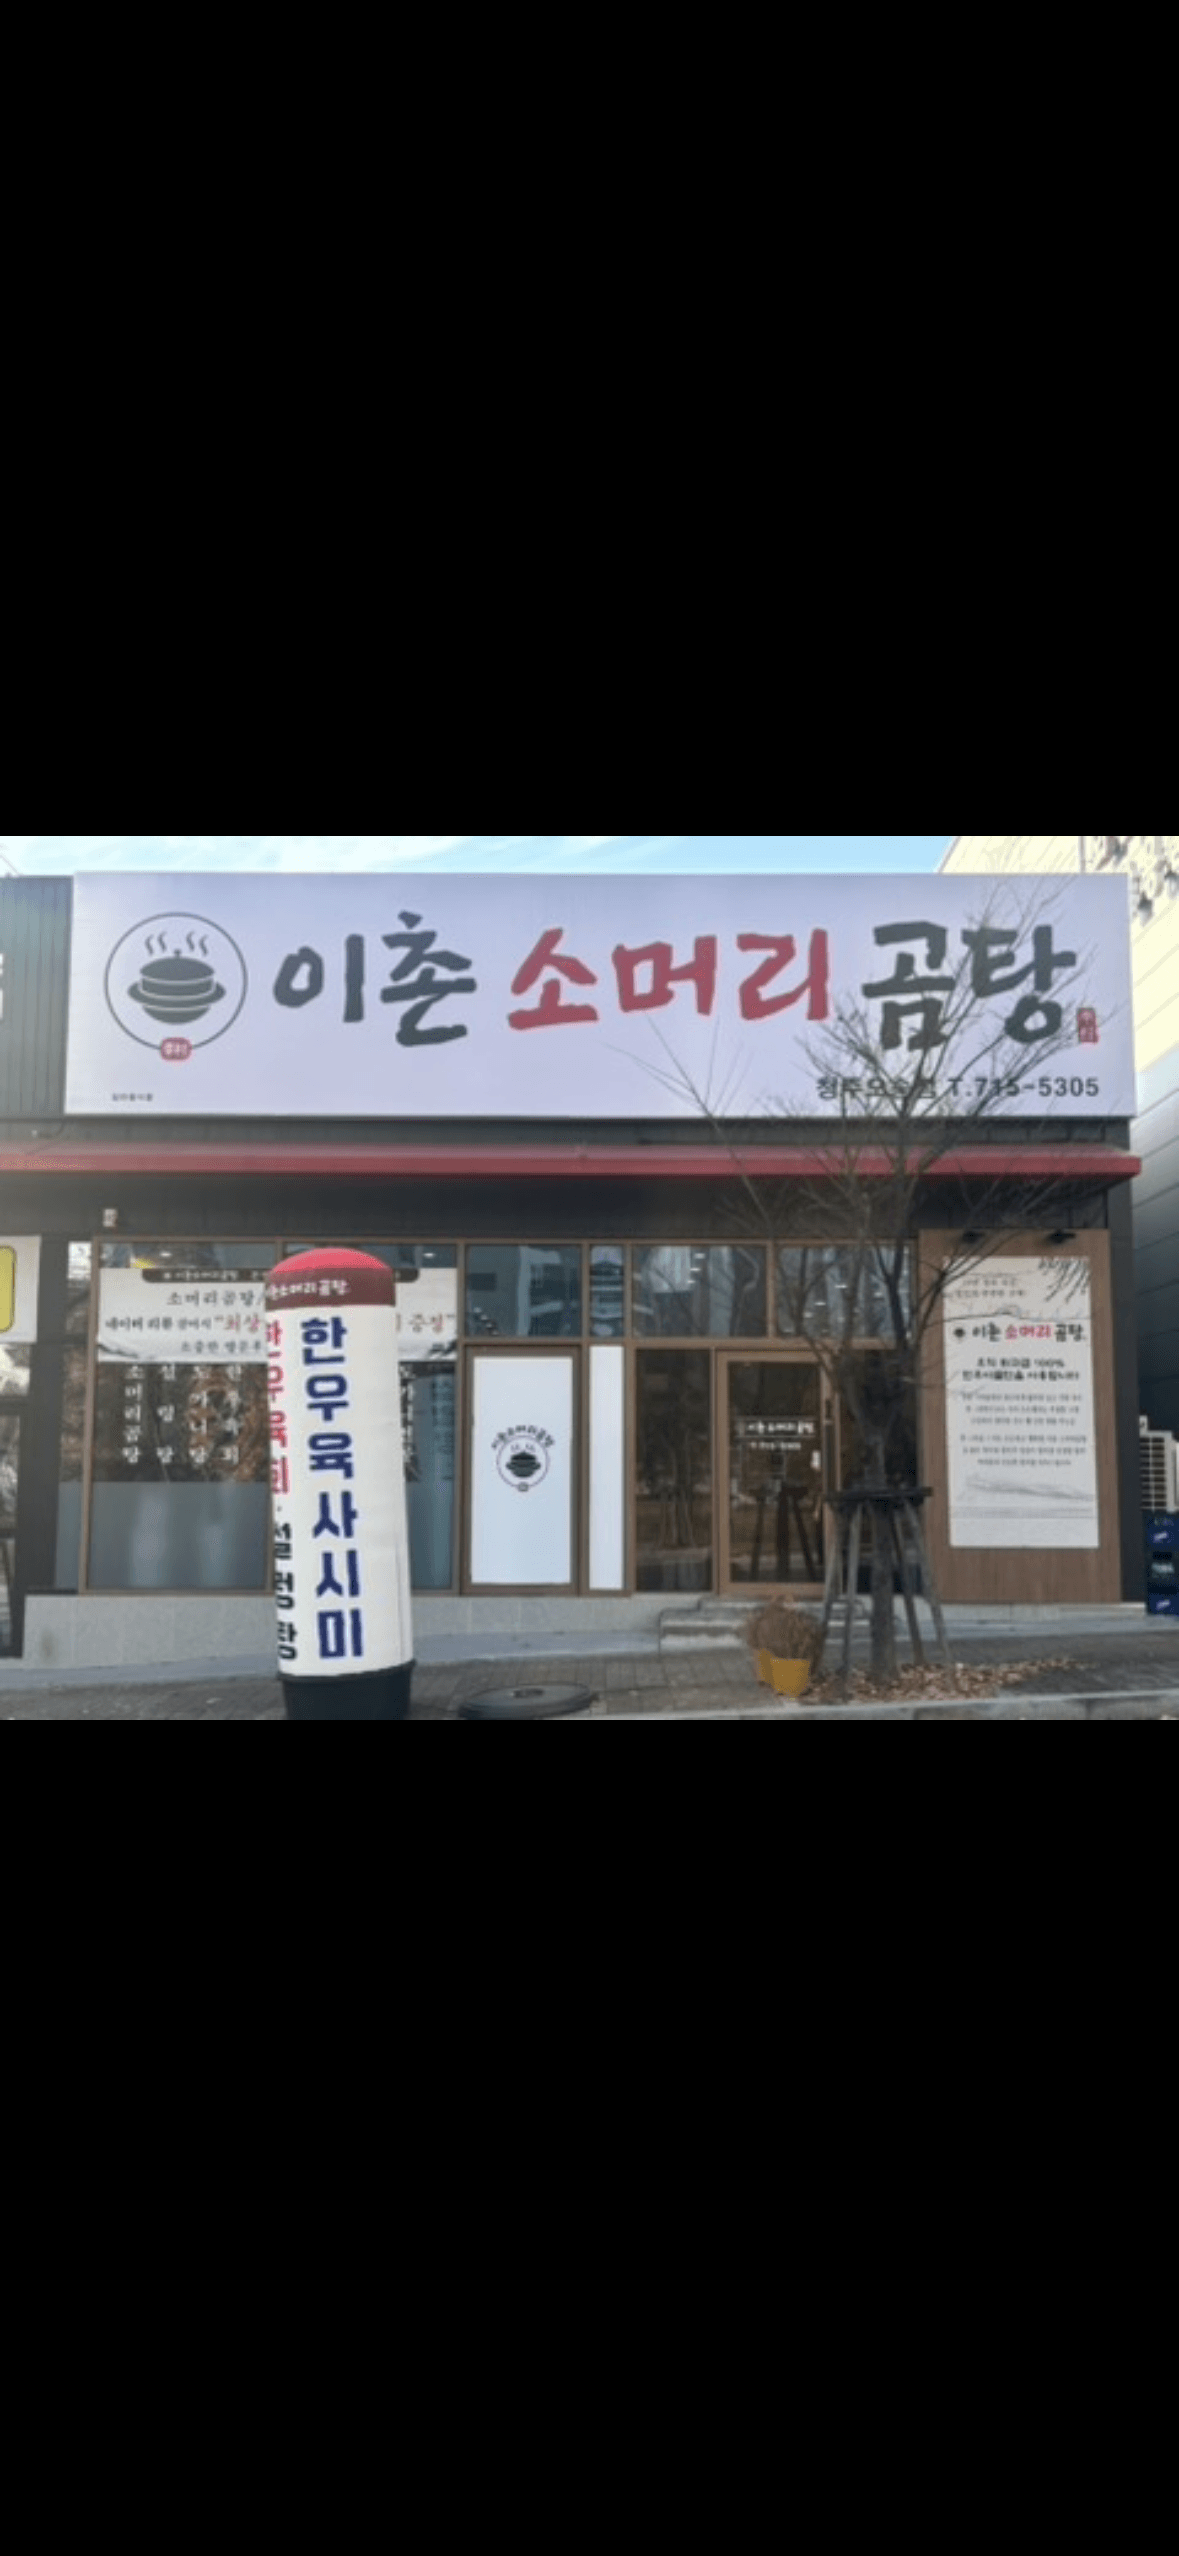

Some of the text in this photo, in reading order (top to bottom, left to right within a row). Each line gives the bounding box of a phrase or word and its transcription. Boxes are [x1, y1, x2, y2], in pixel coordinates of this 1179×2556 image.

[273, 911, 1077, 1051] 이촌 소머리 곰탕
[301, 1316, 363, 1659] 한우육사시미
